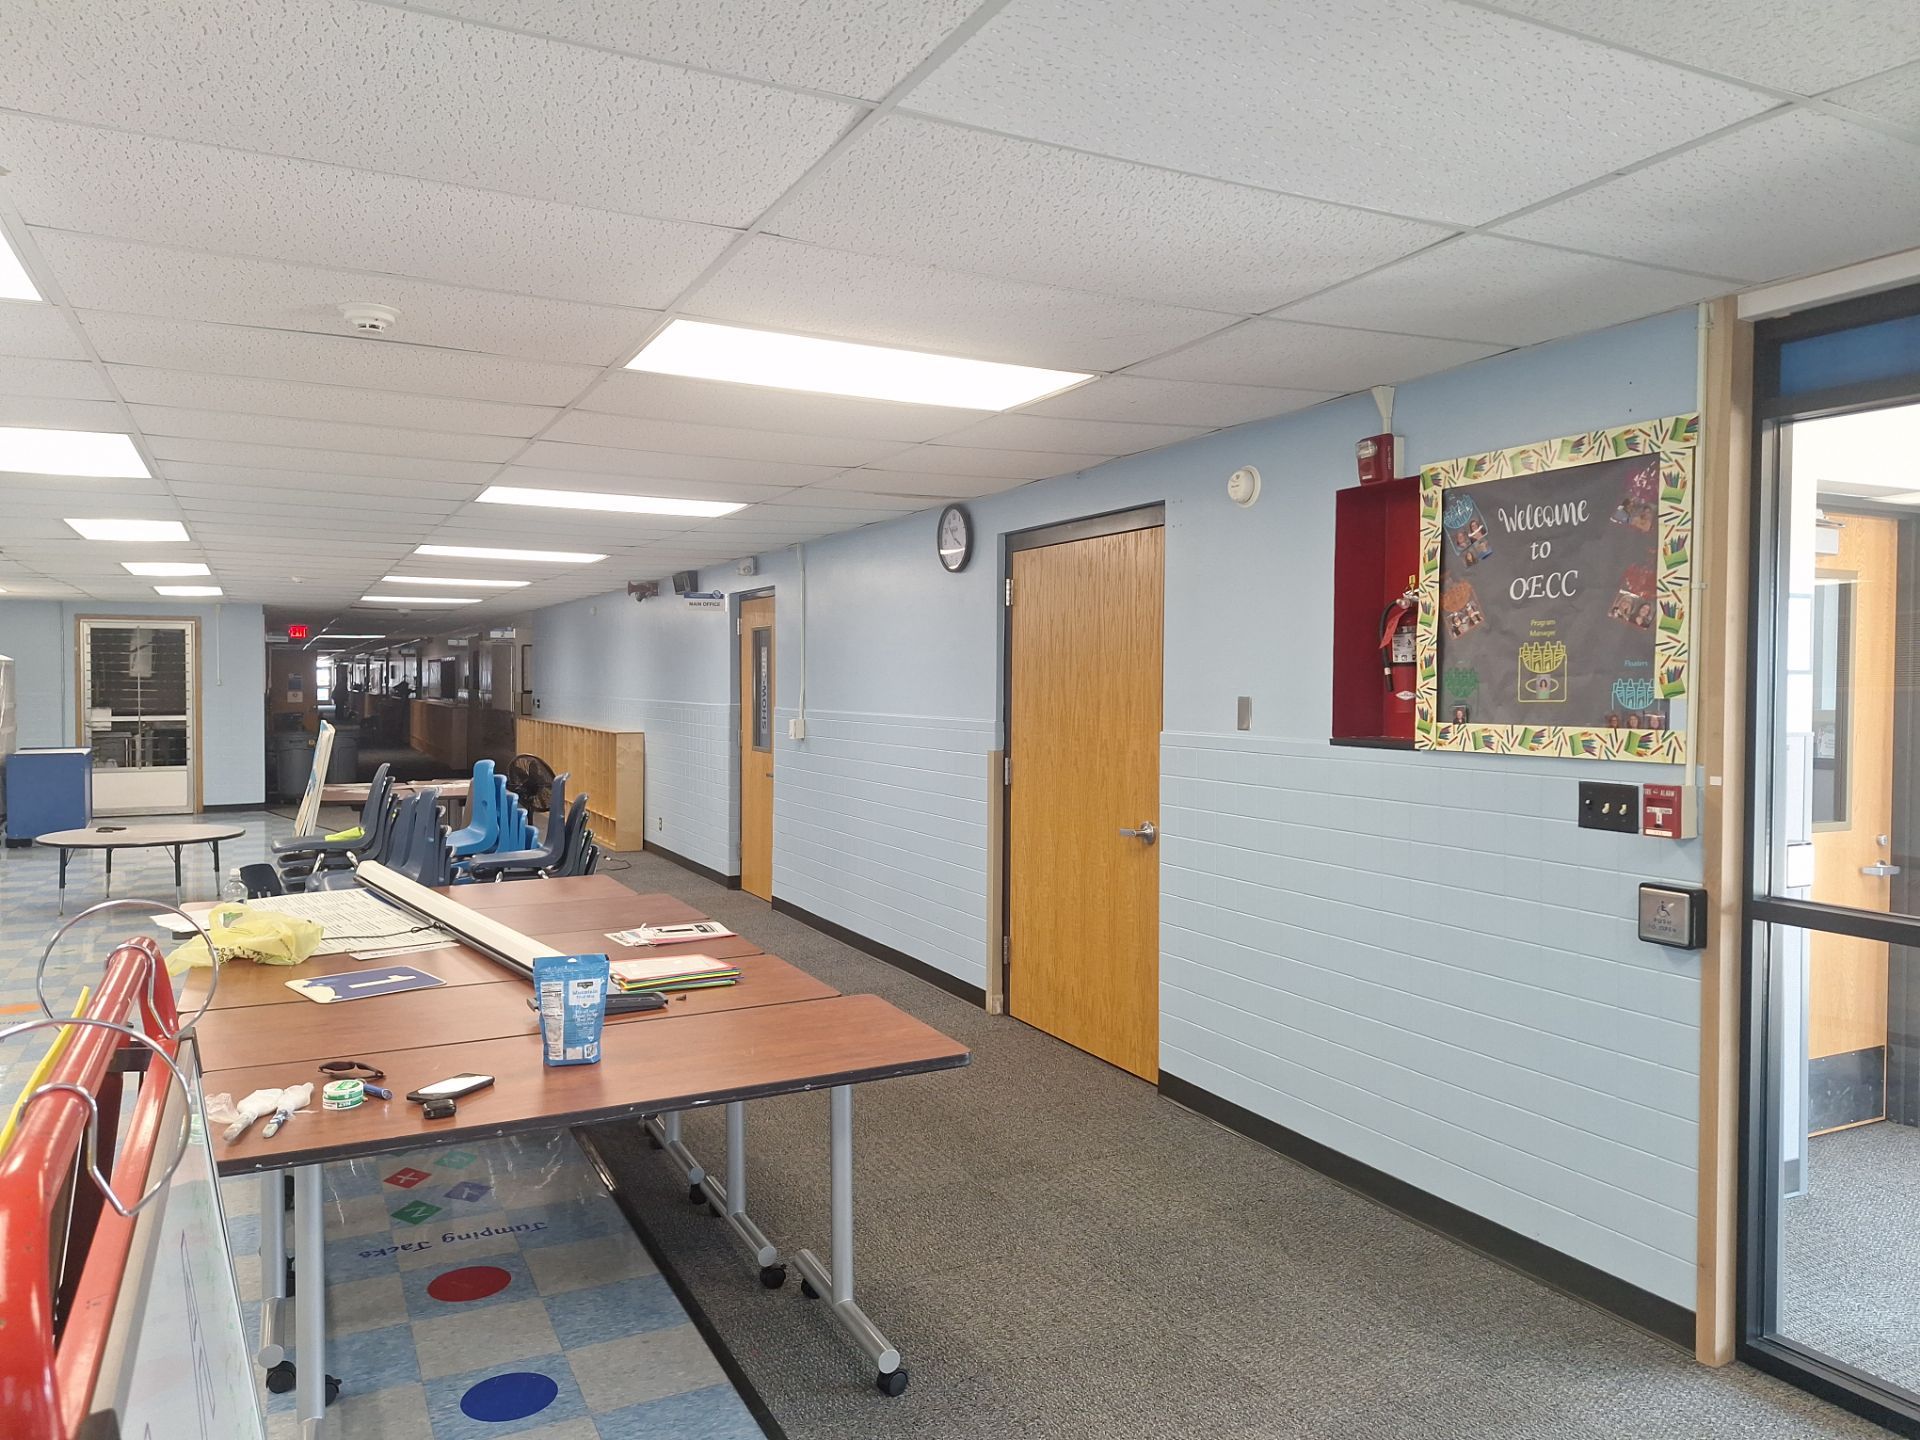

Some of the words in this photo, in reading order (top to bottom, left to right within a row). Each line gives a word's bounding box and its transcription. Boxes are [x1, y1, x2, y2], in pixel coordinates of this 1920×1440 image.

[1498, 499, 1590, 533] Welcome
[1531, 540, 1552, 560] to
[1509, 569, 1579, 601] OECC
[397, 1172, 419, 1184] X
[442, 1221, 549, 1243] Jumping
[358, 1240, 433, 1259] Jacks
